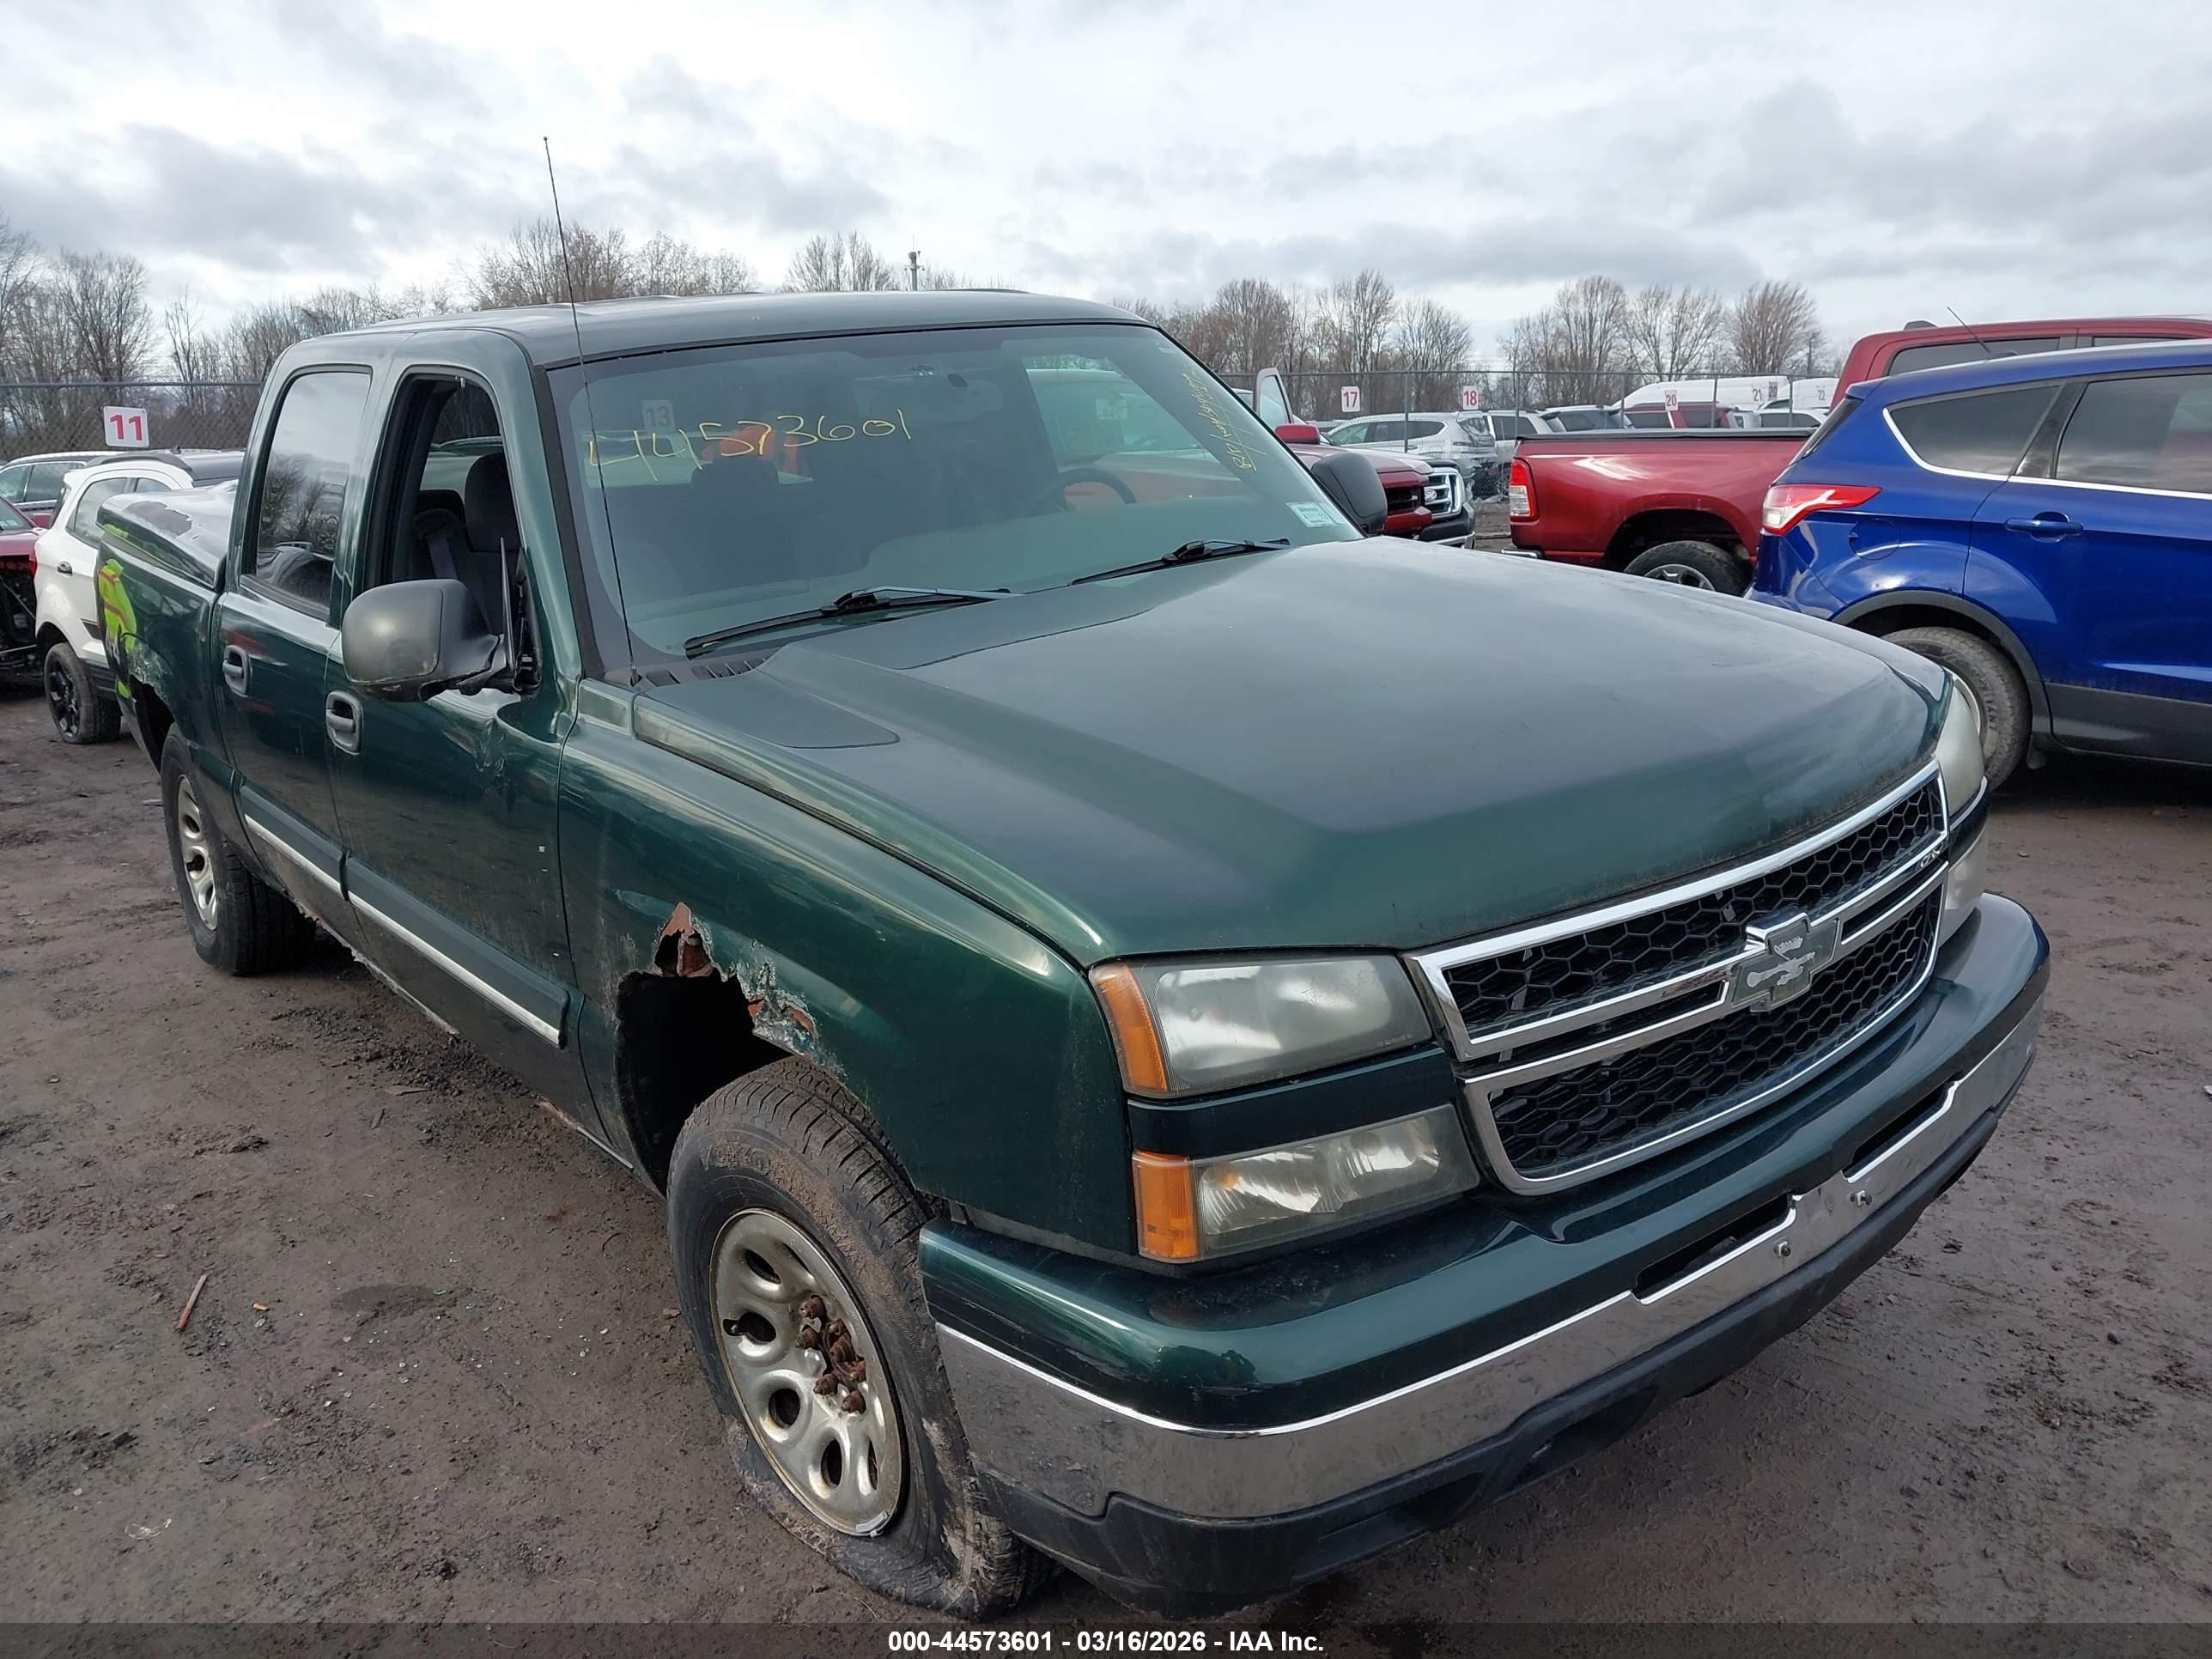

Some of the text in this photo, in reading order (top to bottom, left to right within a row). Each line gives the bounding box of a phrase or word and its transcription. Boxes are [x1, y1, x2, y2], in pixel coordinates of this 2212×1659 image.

[1343, 391, 1358, 408] 17
[1463, 390, 1478, 406] 18
[1666, 394, 1677, 406] 20
[1753, 389, 1763, 402] 21
[645, 405, 671, 428] 13
[110, 415, 143, 441] 11
[589, 408, 912, 482] 44573601
